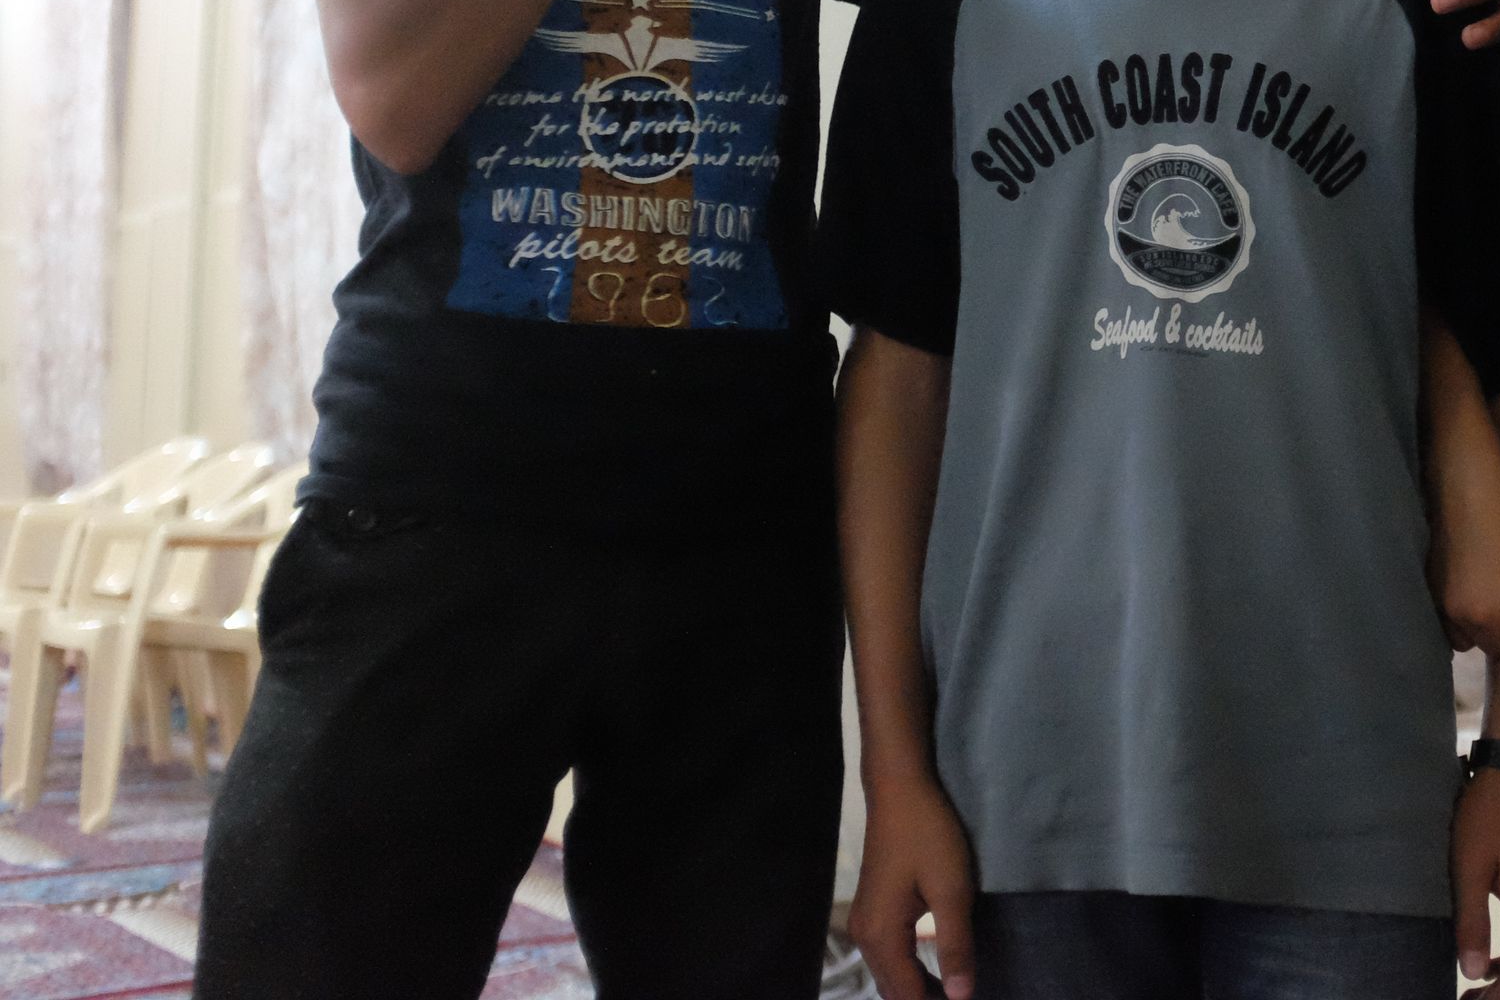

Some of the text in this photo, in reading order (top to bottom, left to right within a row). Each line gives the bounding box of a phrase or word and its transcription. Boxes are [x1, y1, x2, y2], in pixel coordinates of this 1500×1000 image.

[970, 51, 1369, 202] SOUTH COAST ISLAND
[1119, 185, 1139, 210] THE
[1134, 161, 1216, 188] WATERFRONT
[491, 186, 756, 244] WASHINGTON
[509, 228, 745, 271] pilots team
[1090, 303, 1264, 360] Seafood & cocktails
